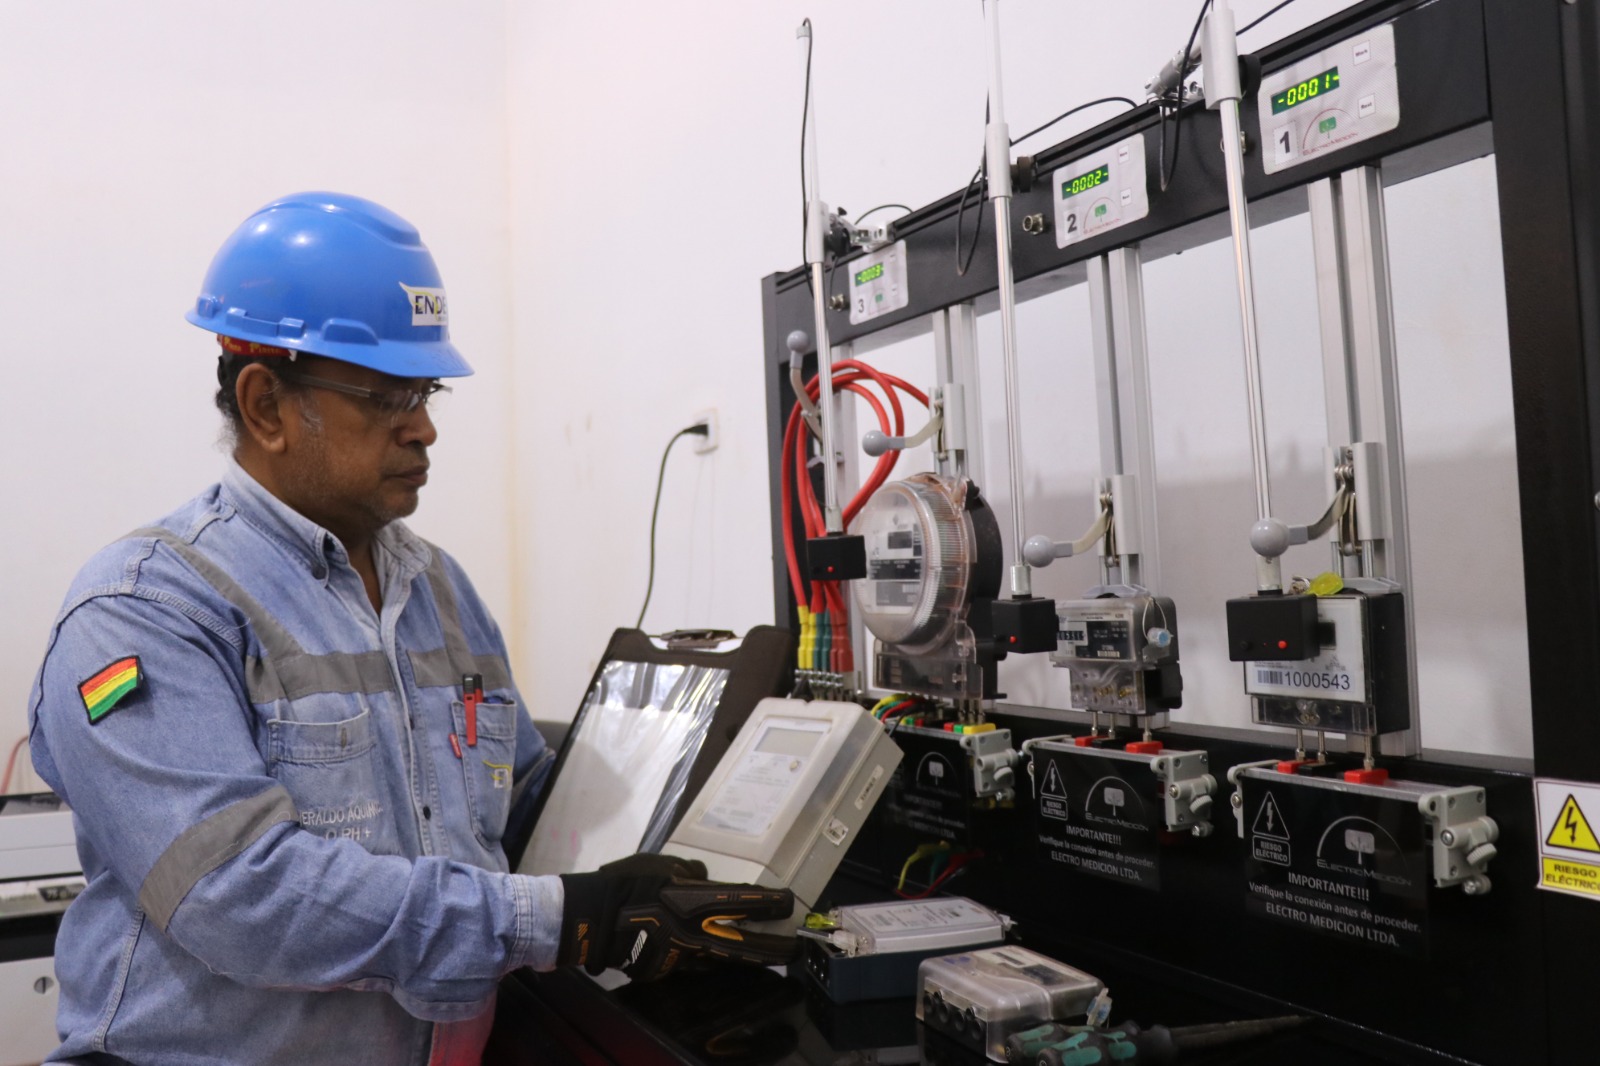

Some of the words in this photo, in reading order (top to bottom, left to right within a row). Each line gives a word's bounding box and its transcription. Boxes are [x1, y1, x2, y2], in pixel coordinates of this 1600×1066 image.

[1279, 131, 1291, 154] 1
[1067, 213, 1078, 234] 2
[858, 299, 865, 313] 3
[1284, 671, 1351, 691] 1000543
[301, 810, 345, 826] ERALDO
[1260, 840, 1282, 853] RIESGO
[1051, 850, 1080, 866] ELECTRO
[1554, 864, 1597, 878] RIESGO
[1288, 872, 1370, 901] IMPORTANTE!!!
[1249, 881, 1284, 900] Verifique
[1285, 890, 1294, 901] la
[1294, 892, 1332, 911] conexión
[1334, 903, 1359, 918] antes
[1360, 908, 1373, 921] de
[1266, 902, 1307, 922] ELECTRO
[1309, 913, 1364, 938] MEDICION
[1367, 928, 1400, 947] LTDA.
